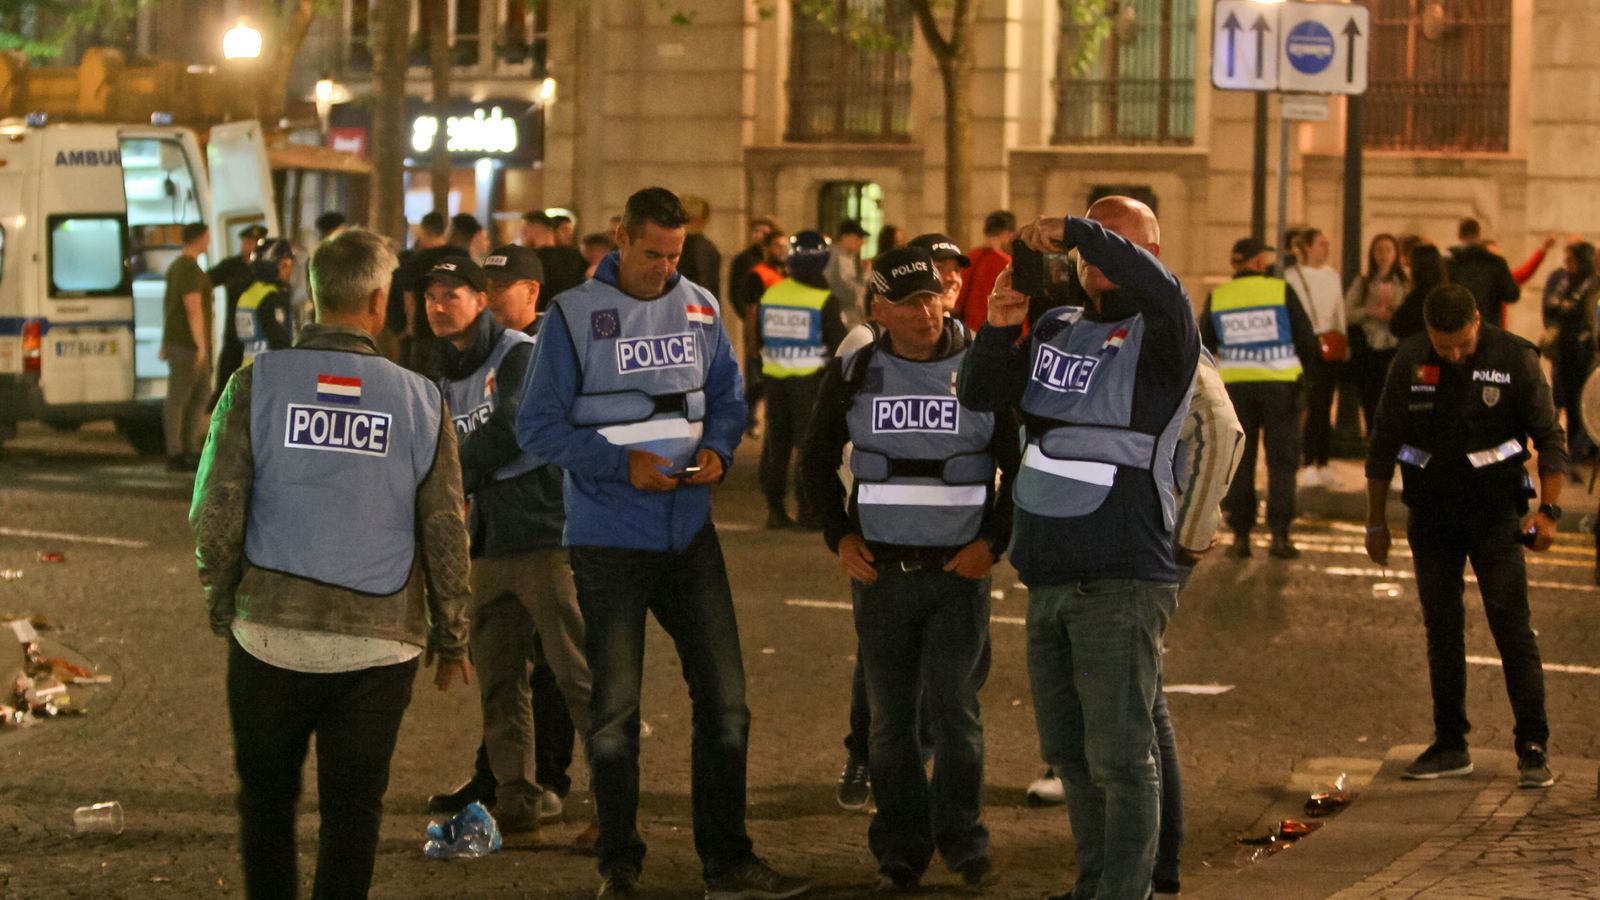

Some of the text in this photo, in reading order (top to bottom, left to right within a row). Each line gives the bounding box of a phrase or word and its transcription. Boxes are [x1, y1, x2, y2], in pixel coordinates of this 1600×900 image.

[891, 261, 928, 278] POLICE
[621, 336, 694, 368] POLICE
[1038, 350, 1093, 387] PLICE
[1472, 369, 1511, 384] POLÍCIA
[292, 410, 386, 450] POLICE
[878, 401, 954, 430] POLICE
